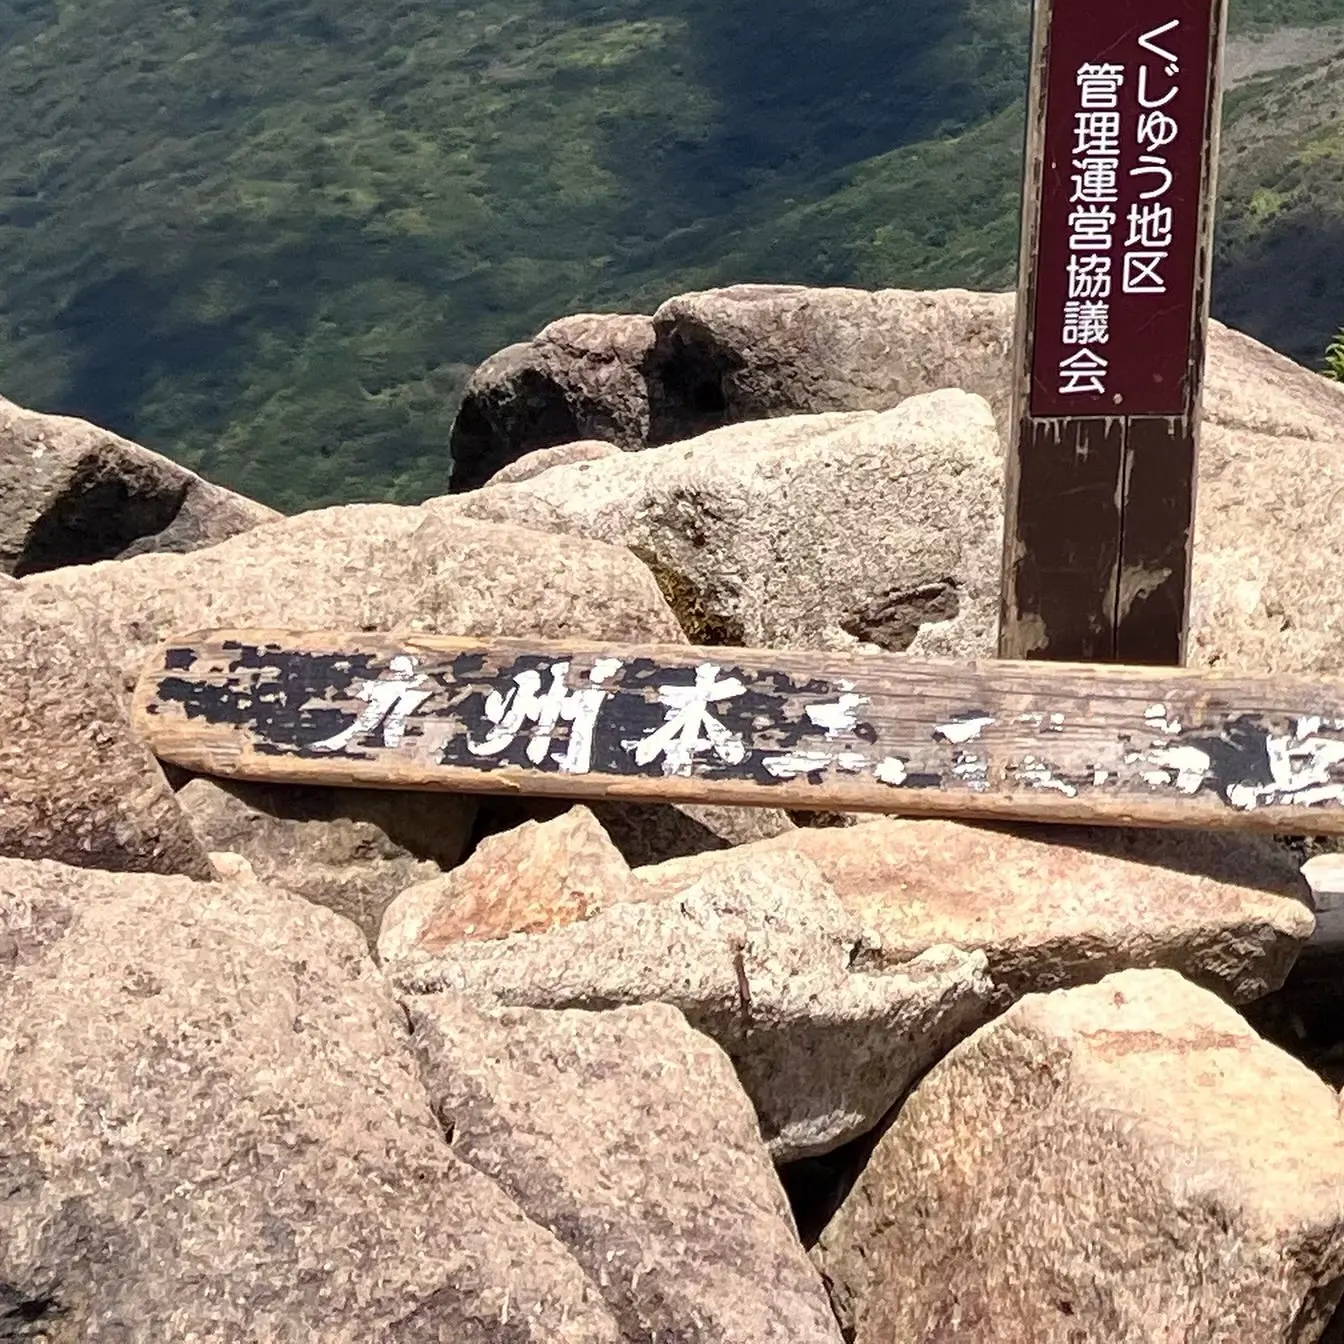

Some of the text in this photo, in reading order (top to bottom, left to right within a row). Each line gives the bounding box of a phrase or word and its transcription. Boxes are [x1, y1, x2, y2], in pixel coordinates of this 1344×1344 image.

[1057, 62, 1125, 395] 管理運営協議会
[1121, 18, 1181, 294] くじゅう地区
